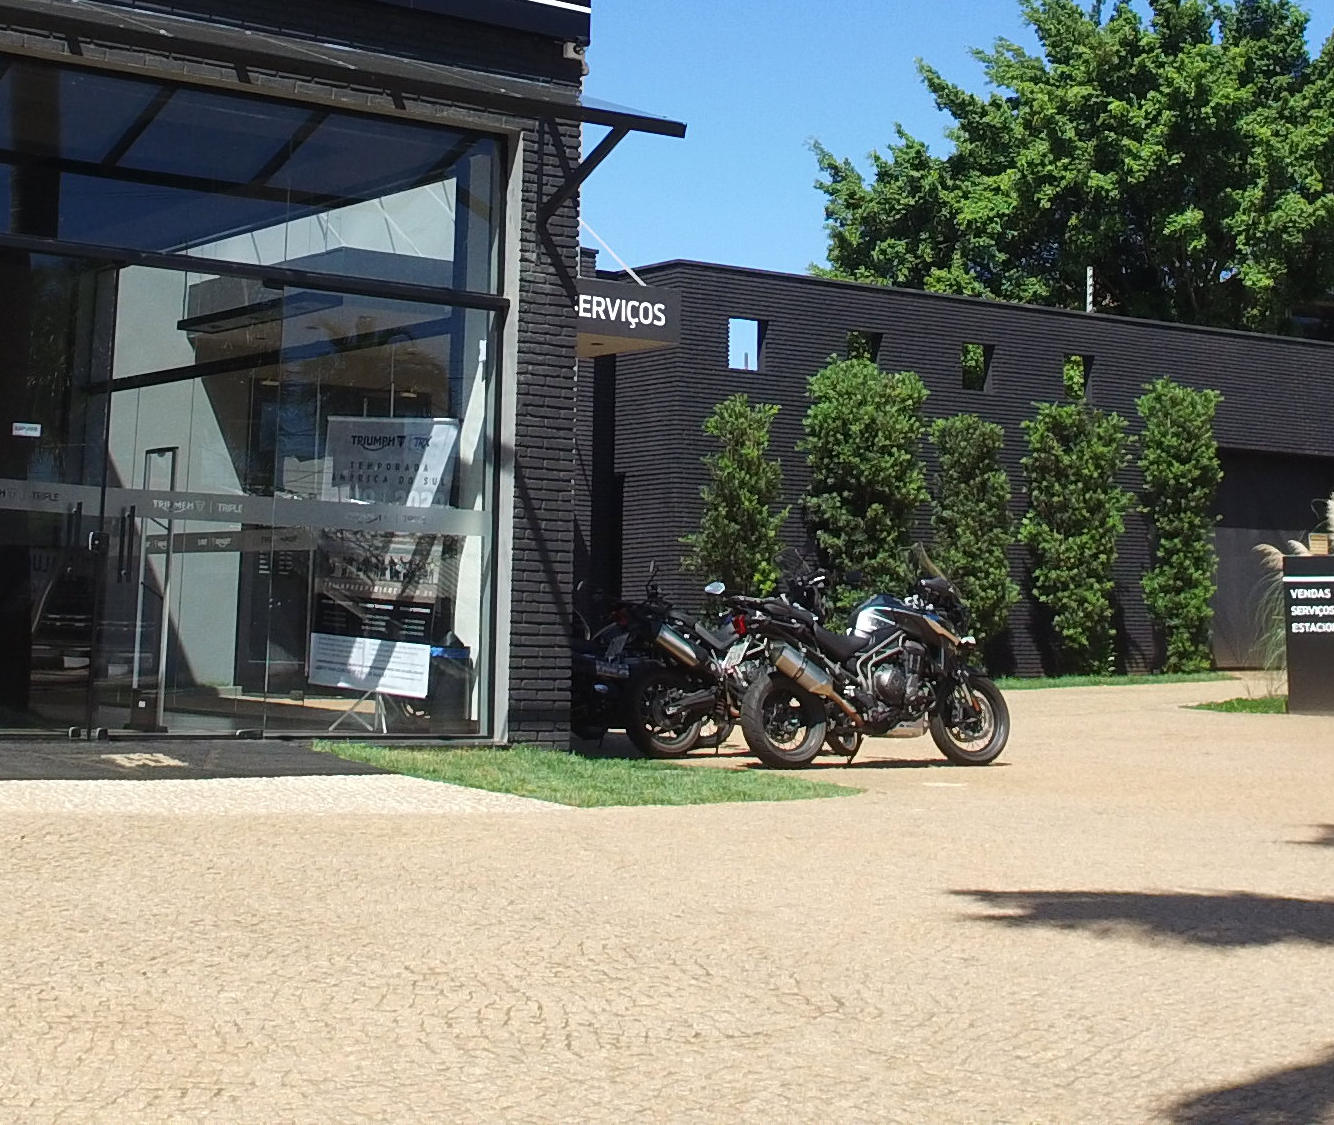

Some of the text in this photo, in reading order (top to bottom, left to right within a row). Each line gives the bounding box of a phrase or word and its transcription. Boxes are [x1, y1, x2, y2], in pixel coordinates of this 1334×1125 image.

[574, 294, 666, 329] ERVIÇOS
[351, 435, 396, 452] TRIUMPH
[1289, 588, 1332, 599] VENDAS
